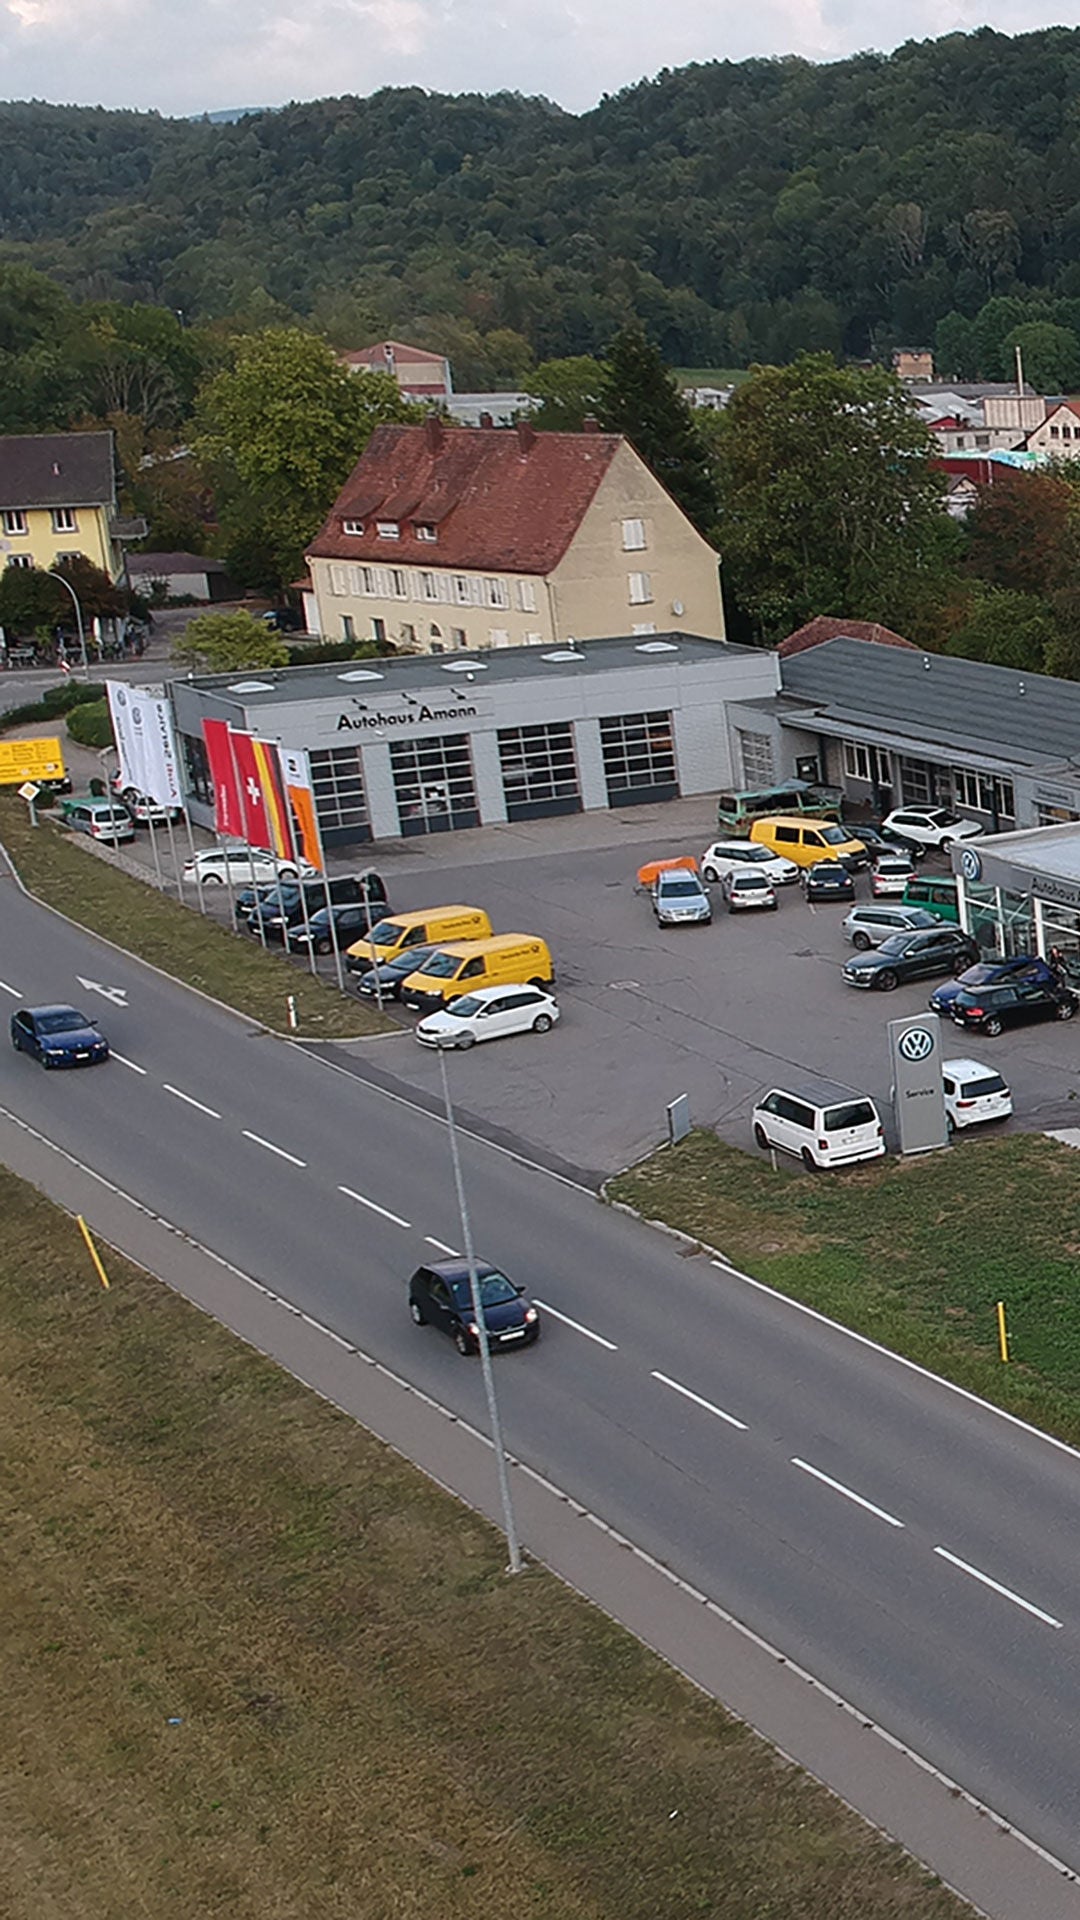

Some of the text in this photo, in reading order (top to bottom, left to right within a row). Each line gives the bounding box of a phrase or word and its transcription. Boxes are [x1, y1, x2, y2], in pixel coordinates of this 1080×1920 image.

[337, 705, 477, 731] Autohaus Amann
[905, 1088, 935, 1099] Service
